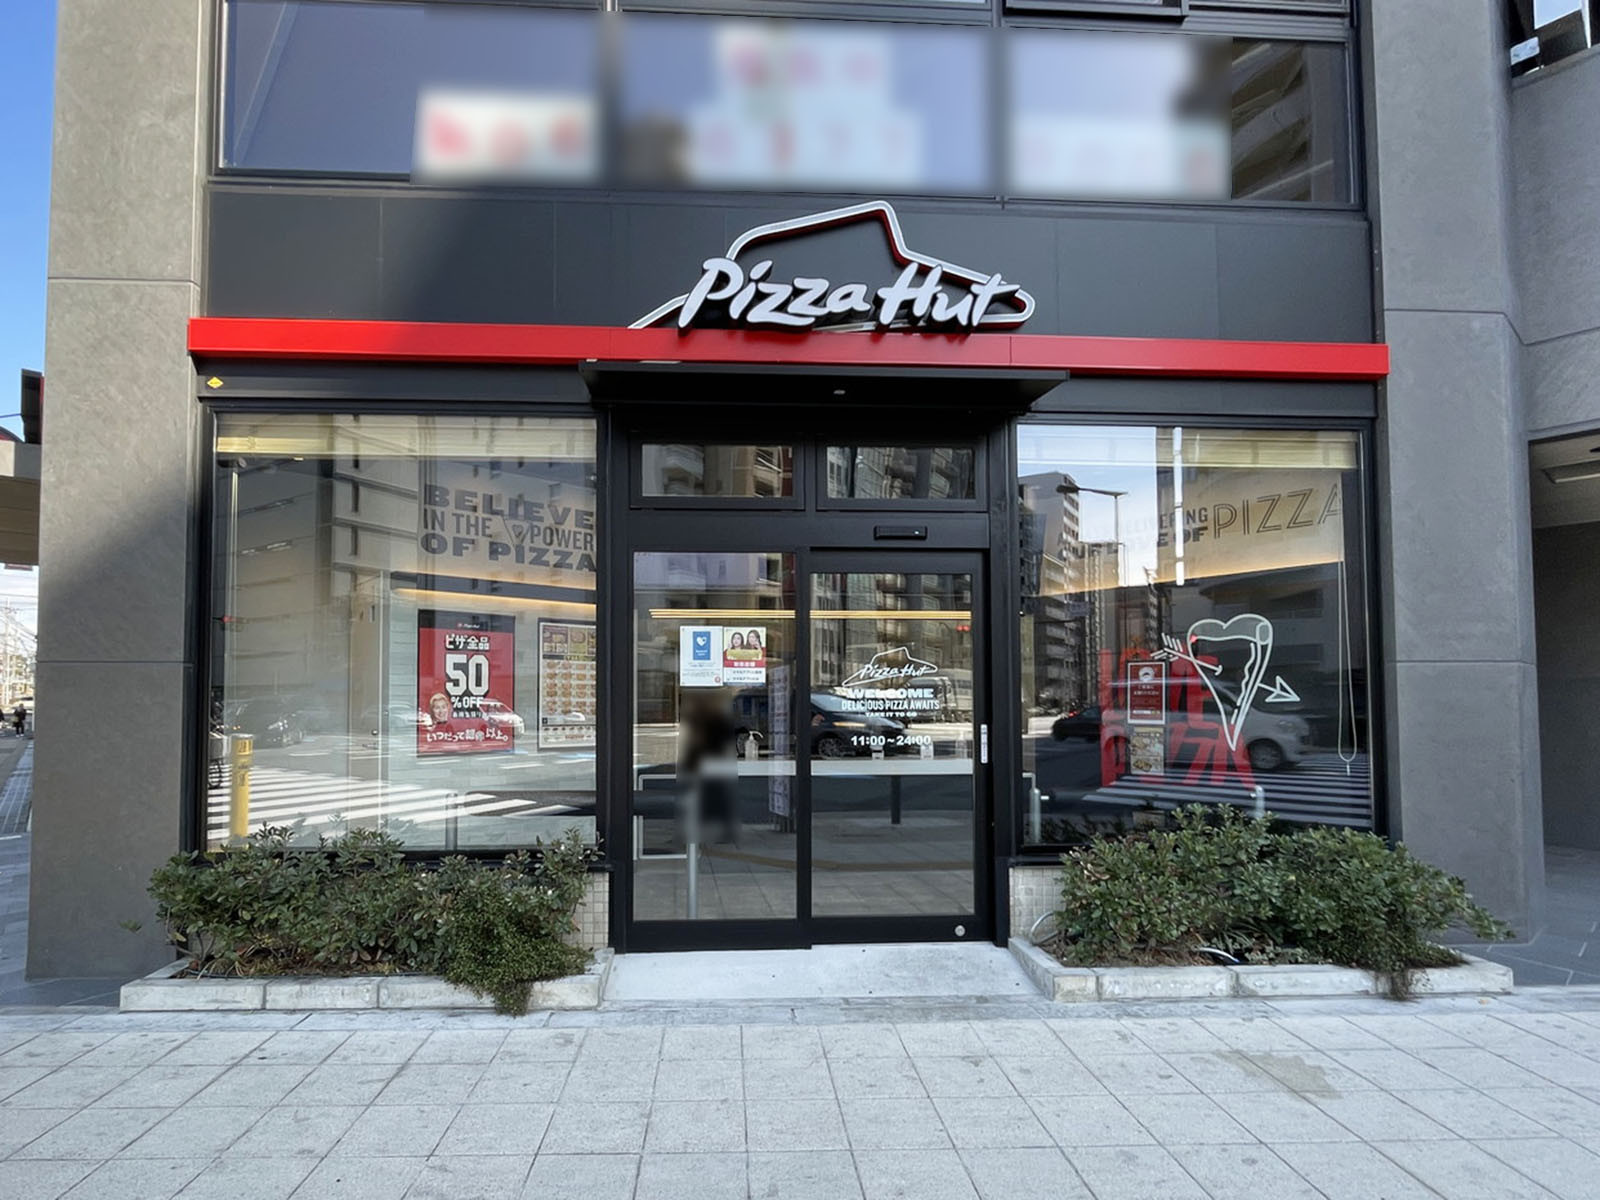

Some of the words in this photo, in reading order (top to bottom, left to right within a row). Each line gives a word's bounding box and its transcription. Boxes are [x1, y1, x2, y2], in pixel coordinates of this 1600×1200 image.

[678, 258, 871, 328] Pizza
[877, 262, 1021, 327] Hut
[424, 485, 595, 530] BELIEVE
[1214, 482, 1342, 540] PIZZA
[423, 508, 446, 532] IN
[452, 513, 493, 538] THE
[530, 525, 594, 550] POWER
[421, 532, 475, 557] OF
[489, 541, 597, 572] PIZZA
[445, 633, 490, 650] ピザ全品
[445, 653, 490, 696] 50
[860, 664, 899, 679] Pizza
[899, 663, 931, 677] Hut
[841, 700, 885, 710] DELICIOUS
[886, 700, 909, 710] PIZZA
[909, 699, 941, 710] AWAITS
